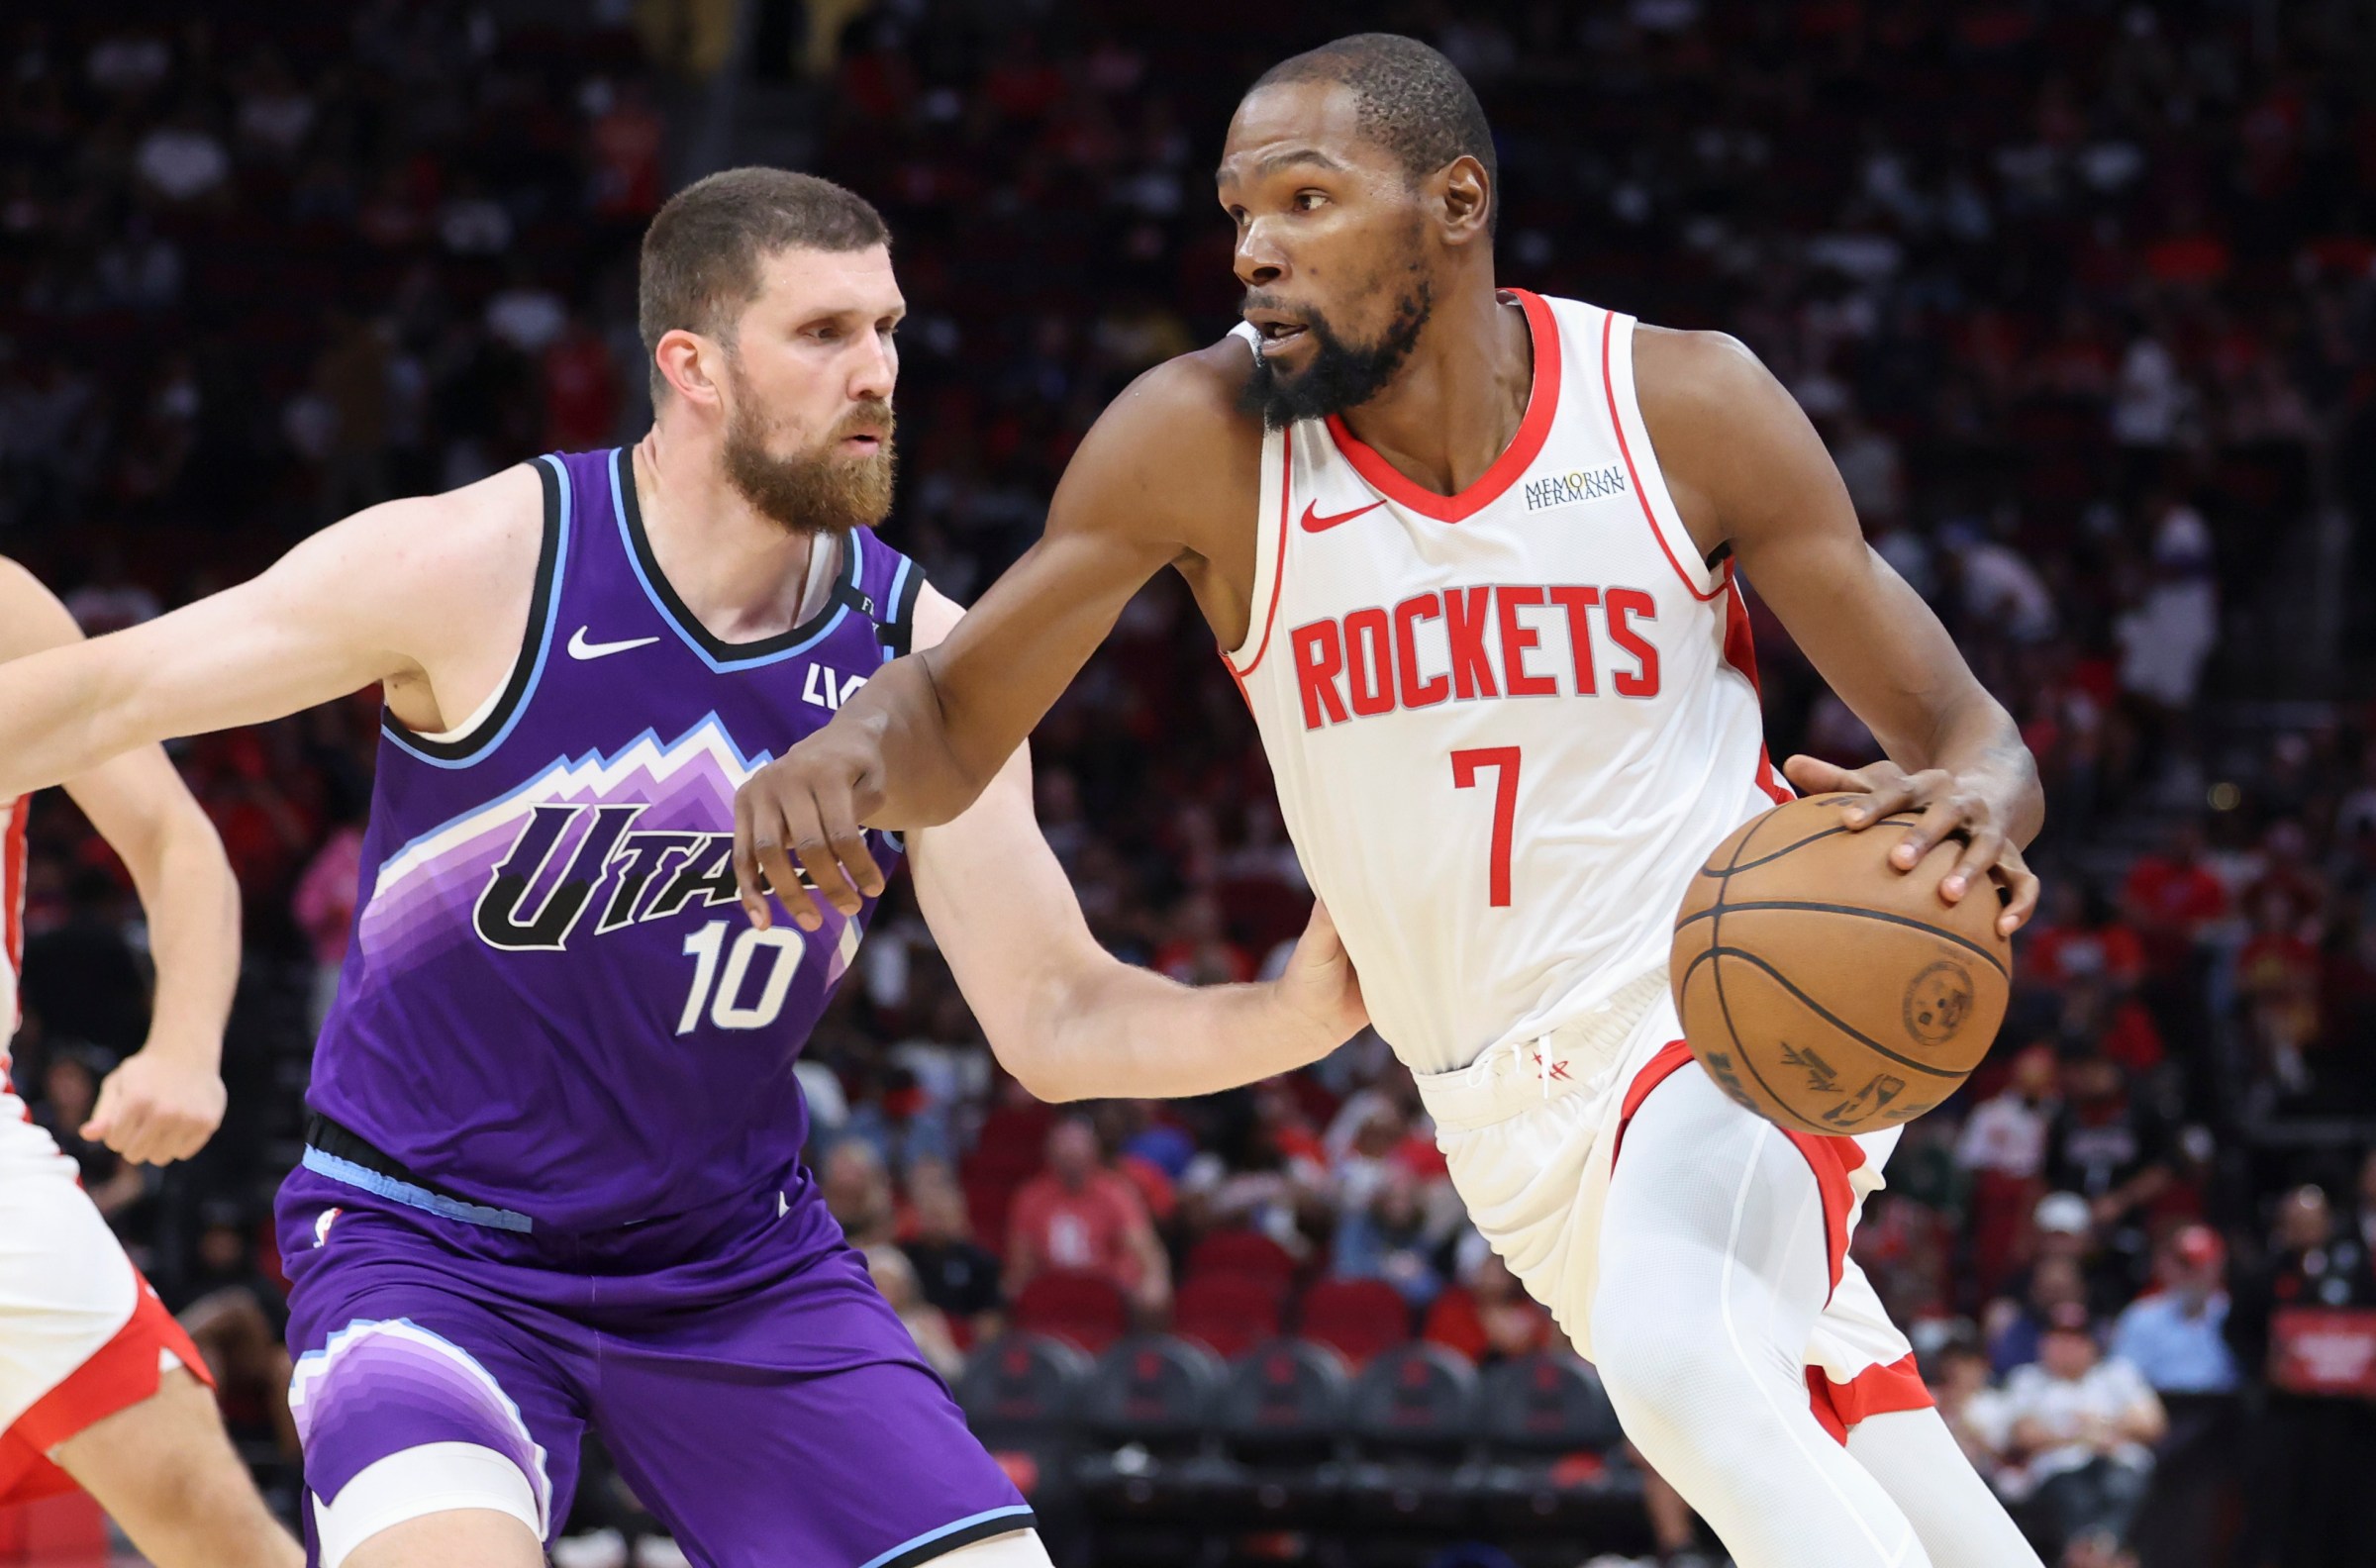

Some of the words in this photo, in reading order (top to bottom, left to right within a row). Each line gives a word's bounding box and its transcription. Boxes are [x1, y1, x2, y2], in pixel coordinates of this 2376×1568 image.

[1525, 465, 1625, 499] MEMORIAL
[1527, 477, 1626, 511] HERMANN
[1289, 583, 1661, 733] ROCKETS
[472, 801, 837, 951] UTA
[1449, 745, 1522, 907] 7
[675, 919, 807, 1036] 10
